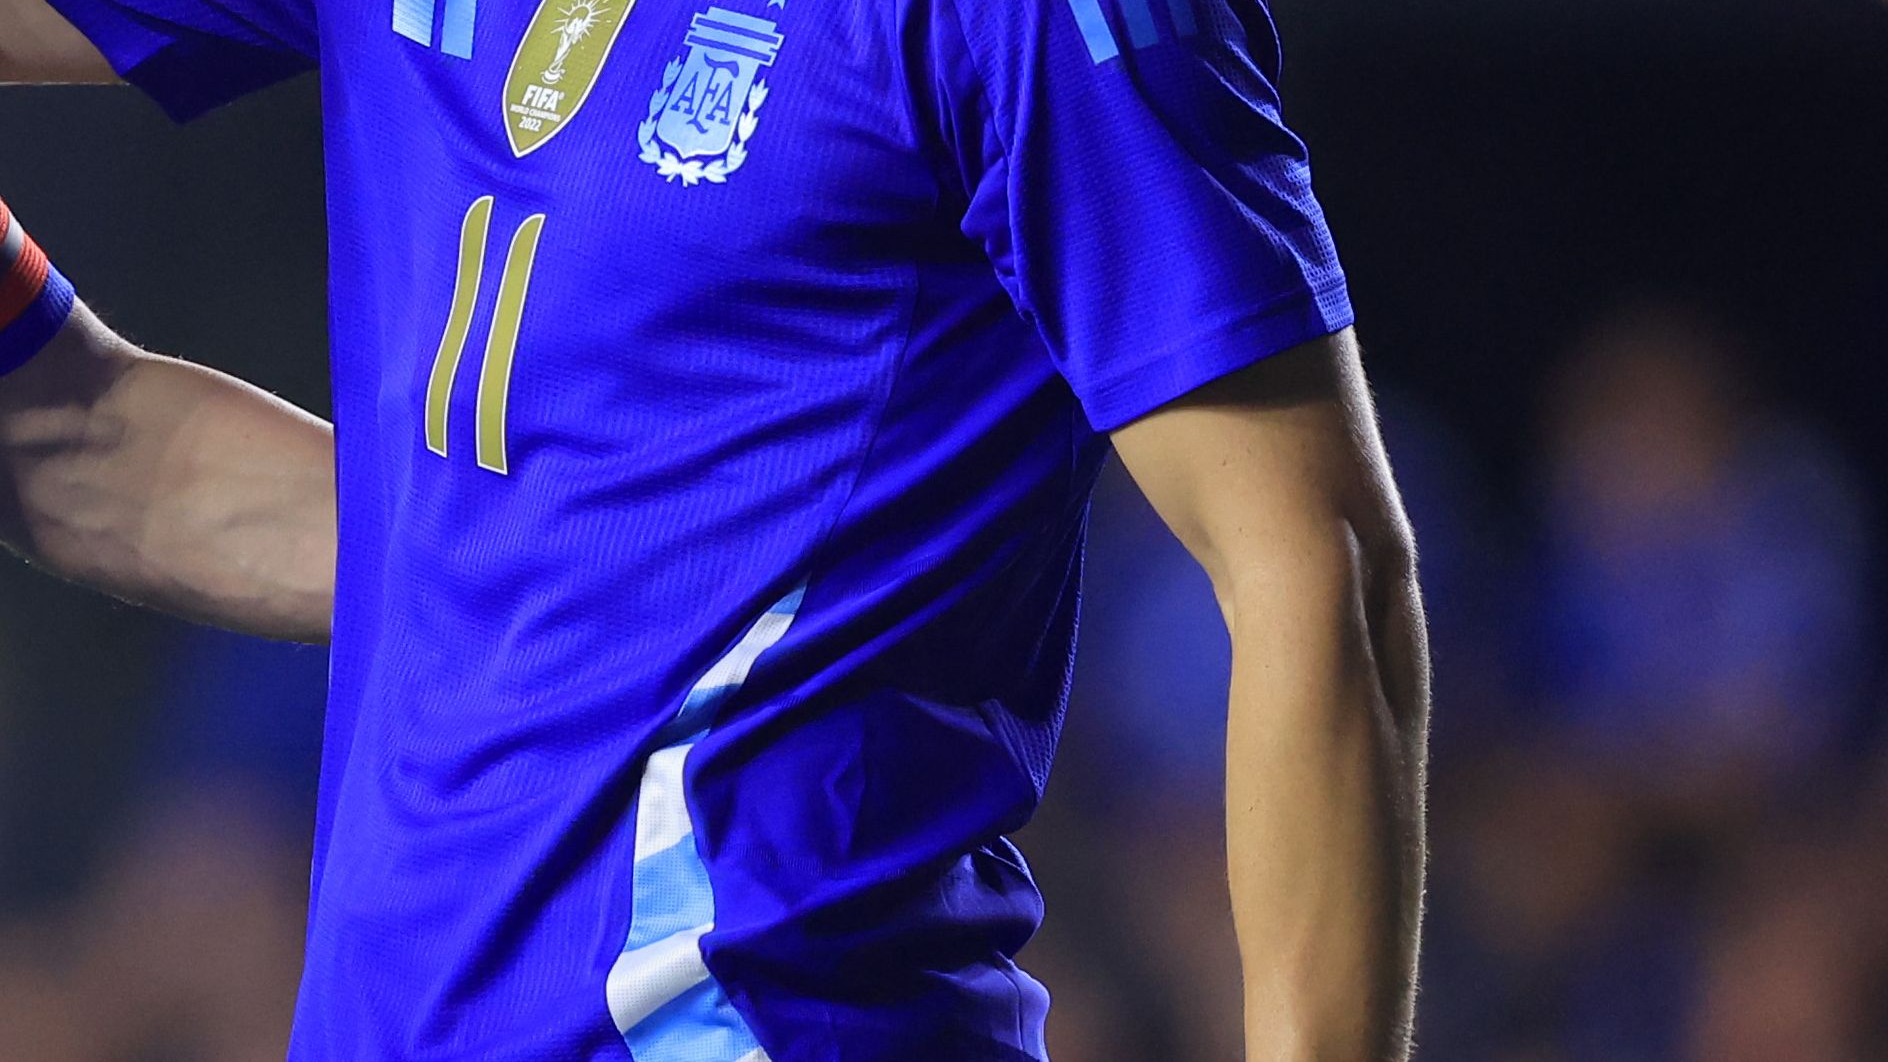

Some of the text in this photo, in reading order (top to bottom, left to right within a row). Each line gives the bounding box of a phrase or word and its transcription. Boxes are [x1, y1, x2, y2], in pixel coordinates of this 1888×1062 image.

[521, 84, 560, 112] FIFA
[670, 52, 739, 134] AFA
[425, 195, 546, 476] 11
